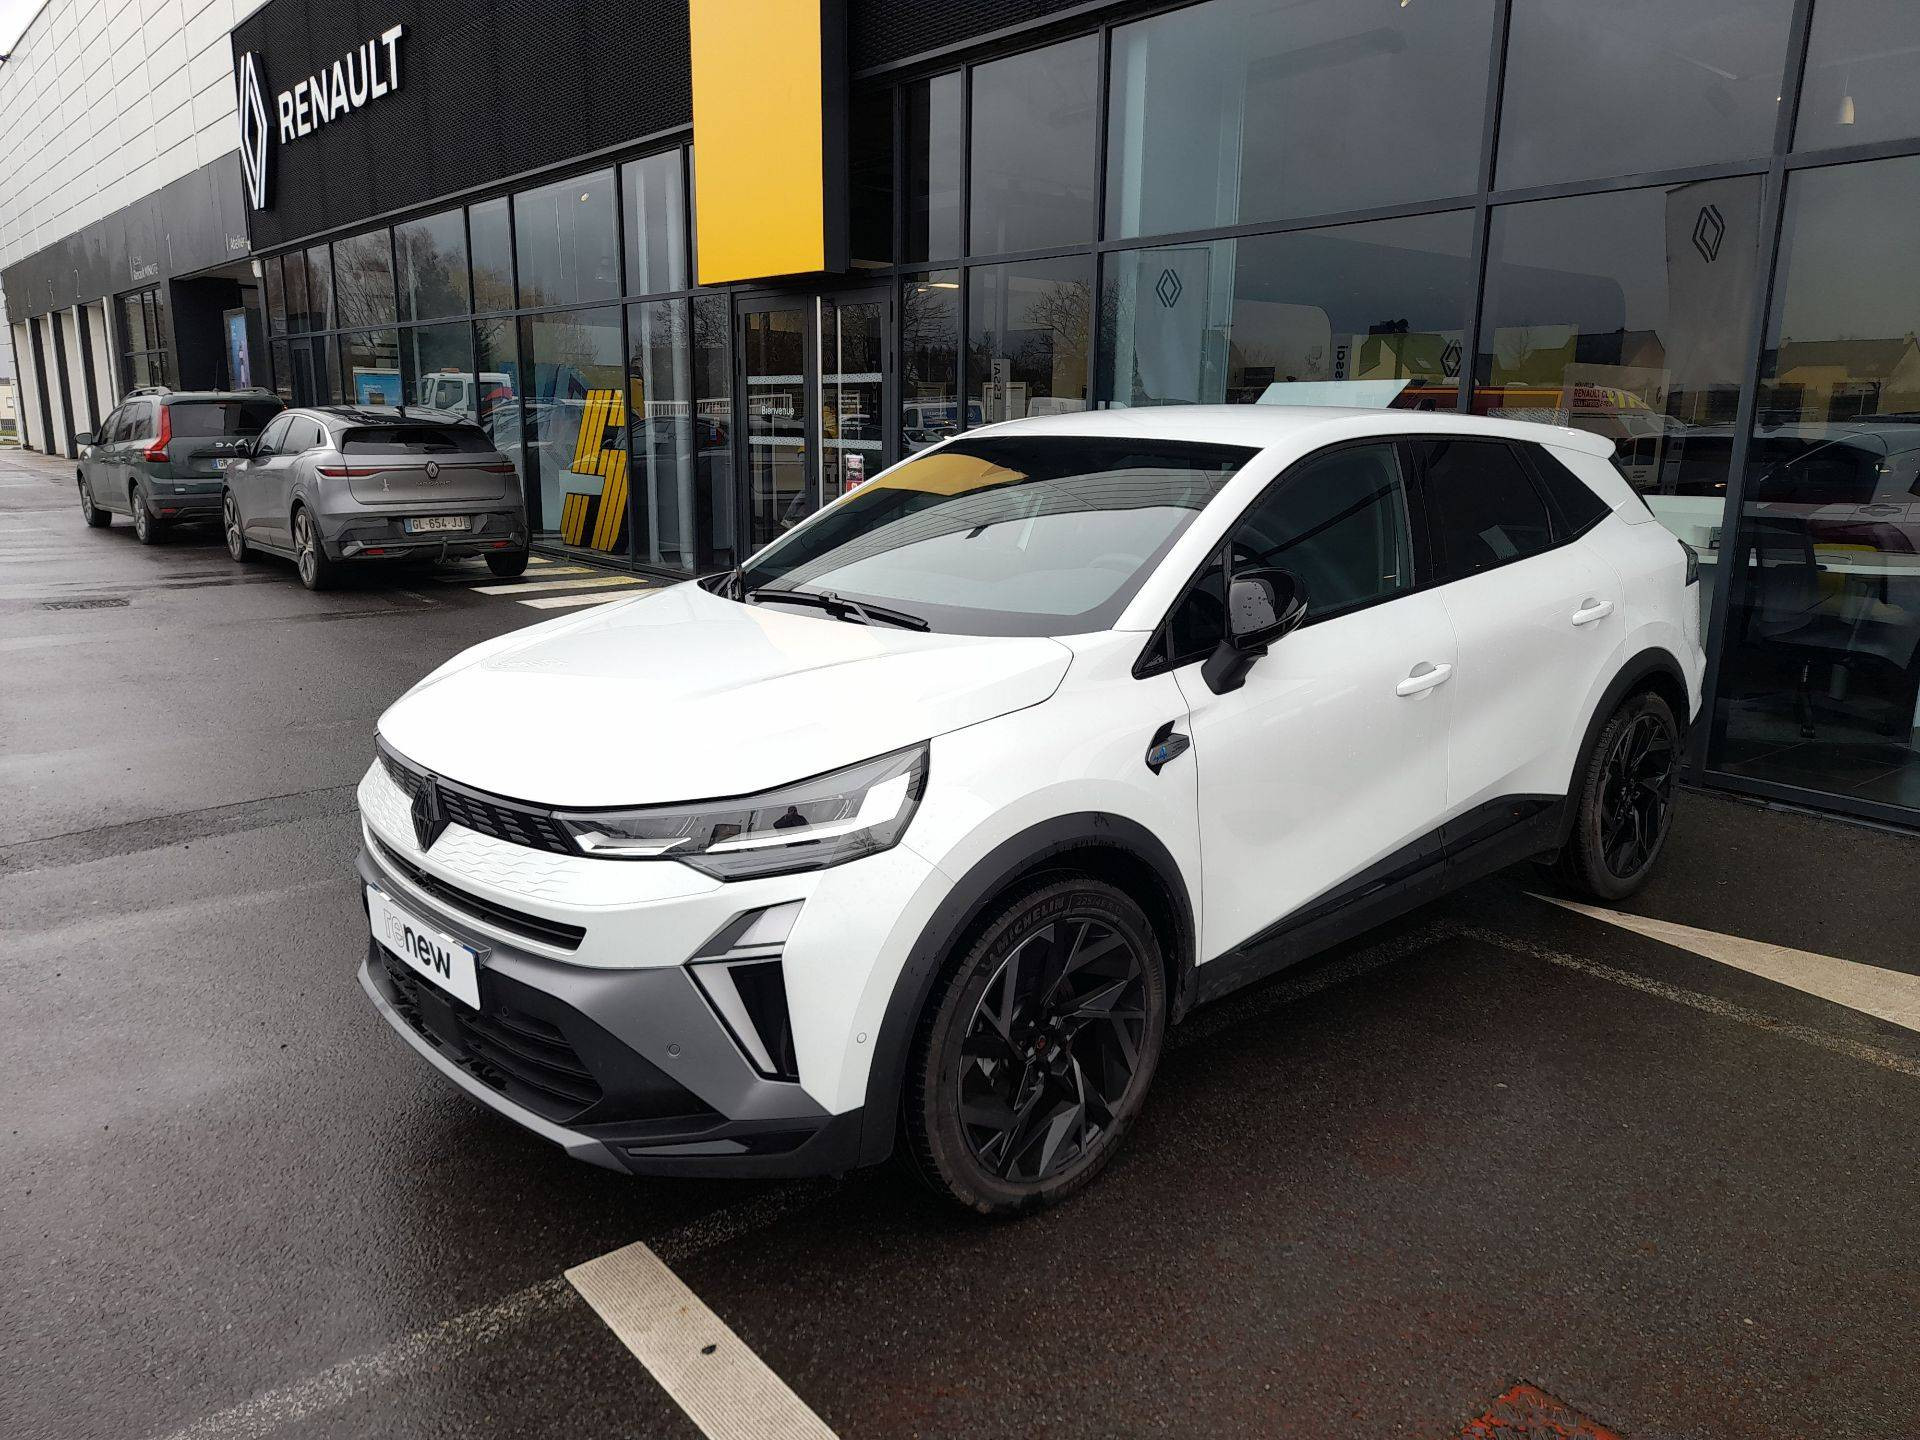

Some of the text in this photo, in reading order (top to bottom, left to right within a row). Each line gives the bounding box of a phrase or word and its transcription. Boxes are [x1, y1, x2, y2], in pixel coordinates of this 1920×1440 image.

[277, 24, 403, 145] RENAULT
[761, 405, 795, 416] Bienvenue
[1574, 388, 1600, 399] RENAULT
[383, 908, 451, 980] renew
[997, 896, 1065, 955] MICHELIN
